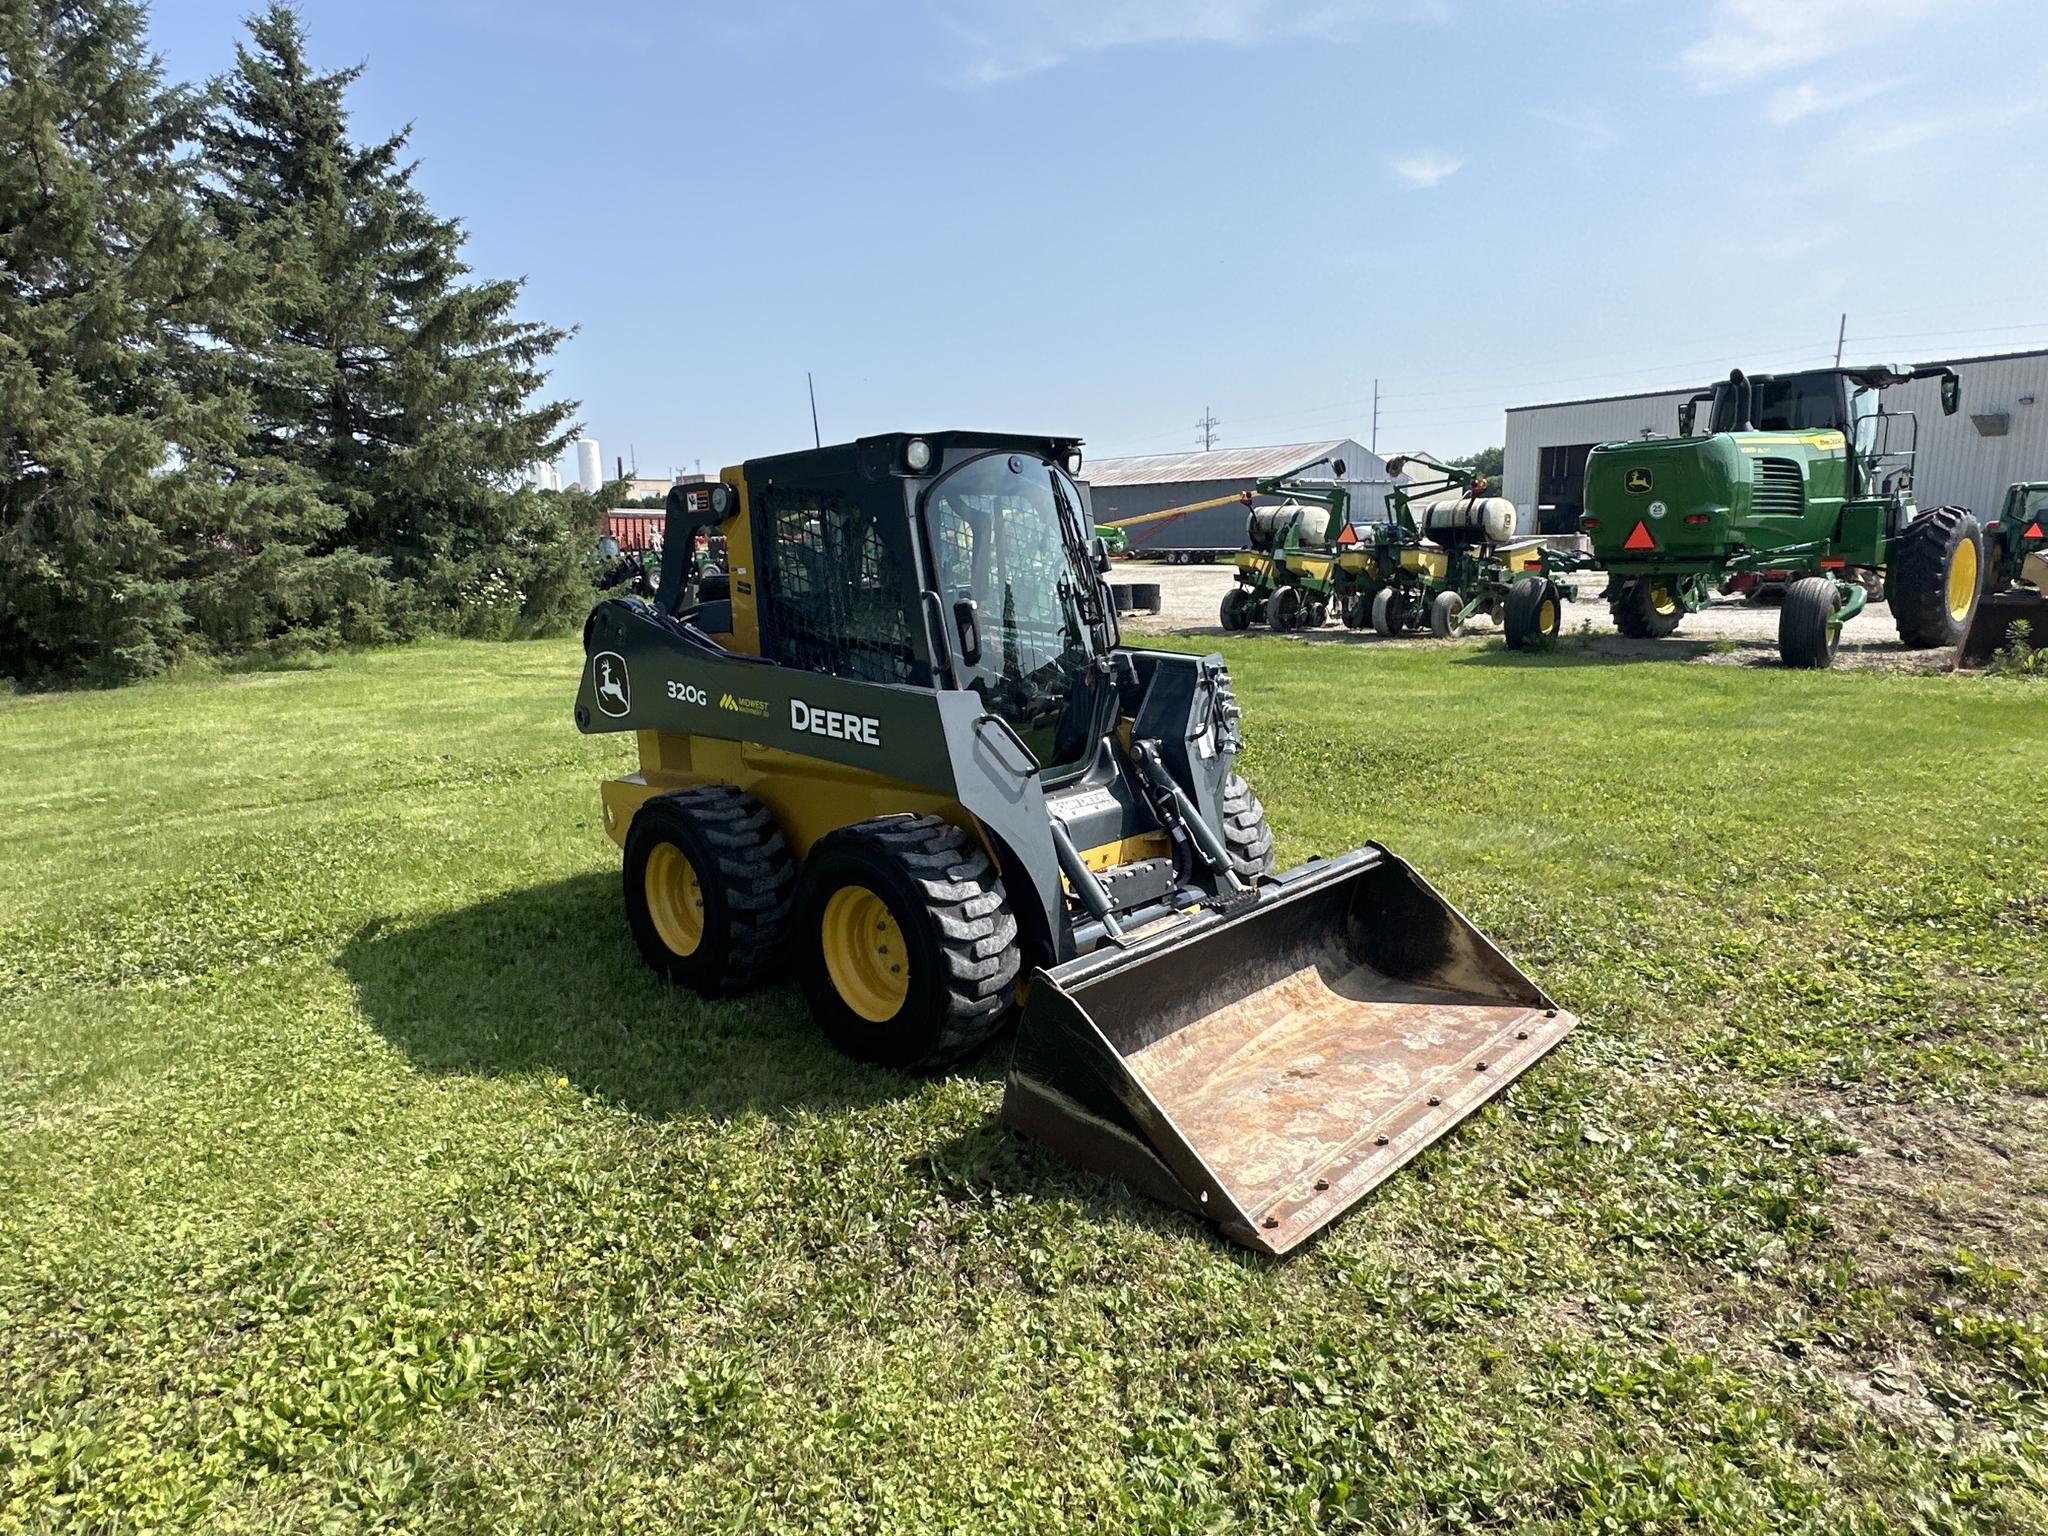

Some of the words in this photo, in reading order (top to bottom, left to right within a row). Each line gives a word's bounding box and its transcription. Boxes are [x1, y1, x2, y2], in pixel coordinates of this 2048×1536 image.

[1652, 504, 1663, 513] 25
[667, 680, 707, 706] 320G
[738, 697, 769, 711] MIDWEST
[790, 699, 880, 746] DEERE
